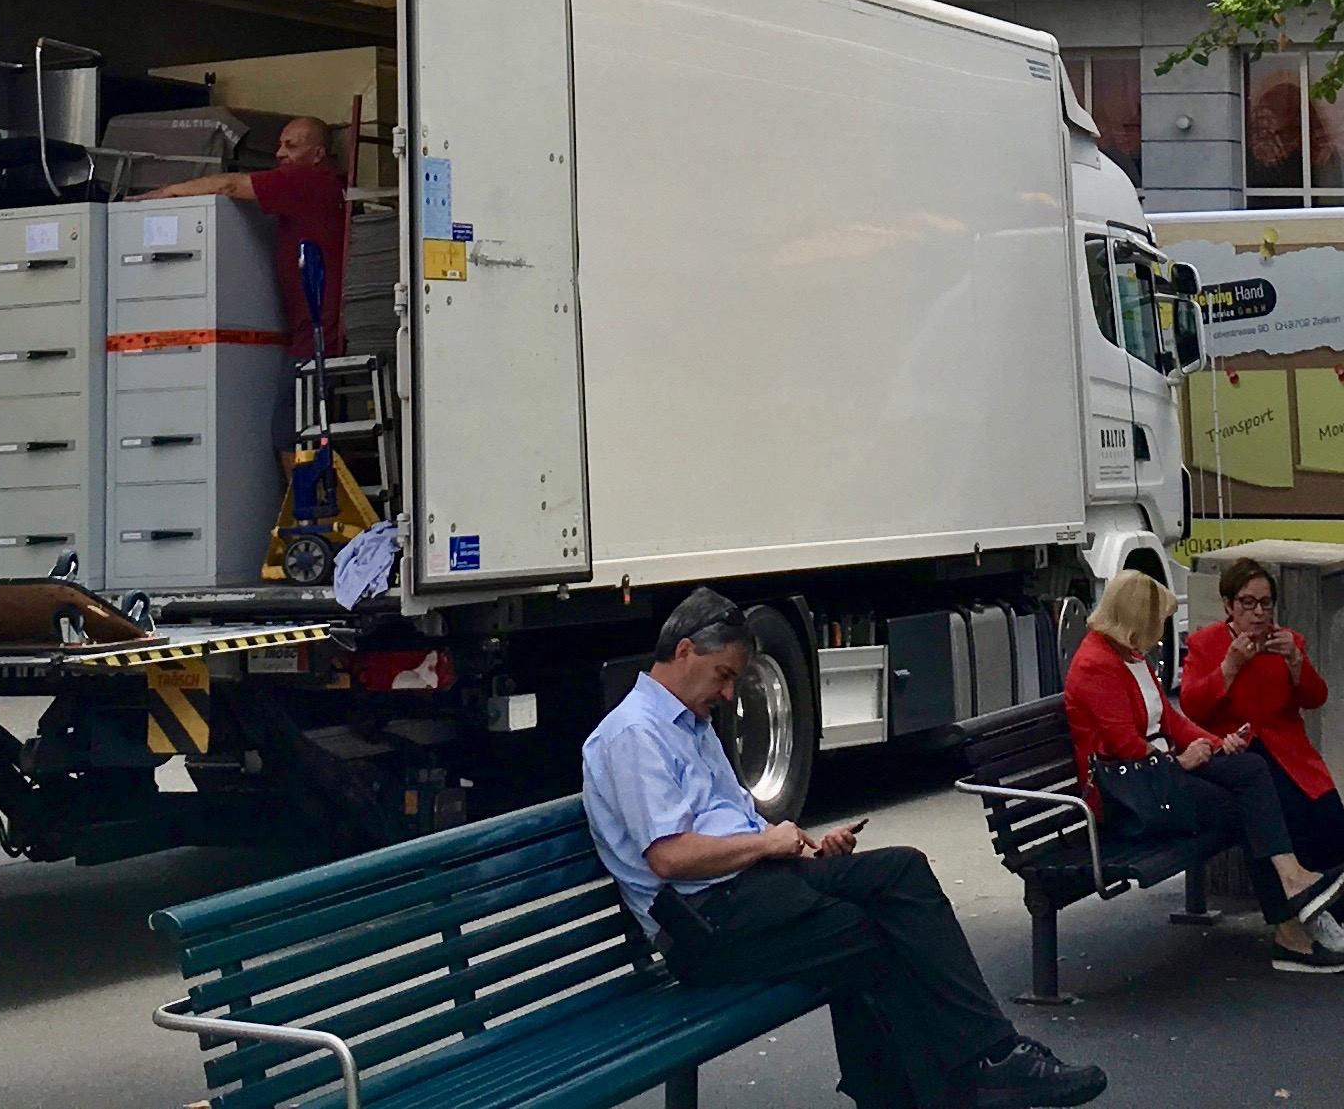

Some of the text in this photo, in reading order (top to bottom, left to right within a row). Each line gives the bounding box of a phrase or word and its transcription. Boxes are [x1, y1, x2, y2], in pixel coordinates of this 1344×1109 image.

[1234, 283, 1264, 301] Hand
[1205, 409, 1274, 443] Transport
[1100, 429, 1126, 448] BALTIS
